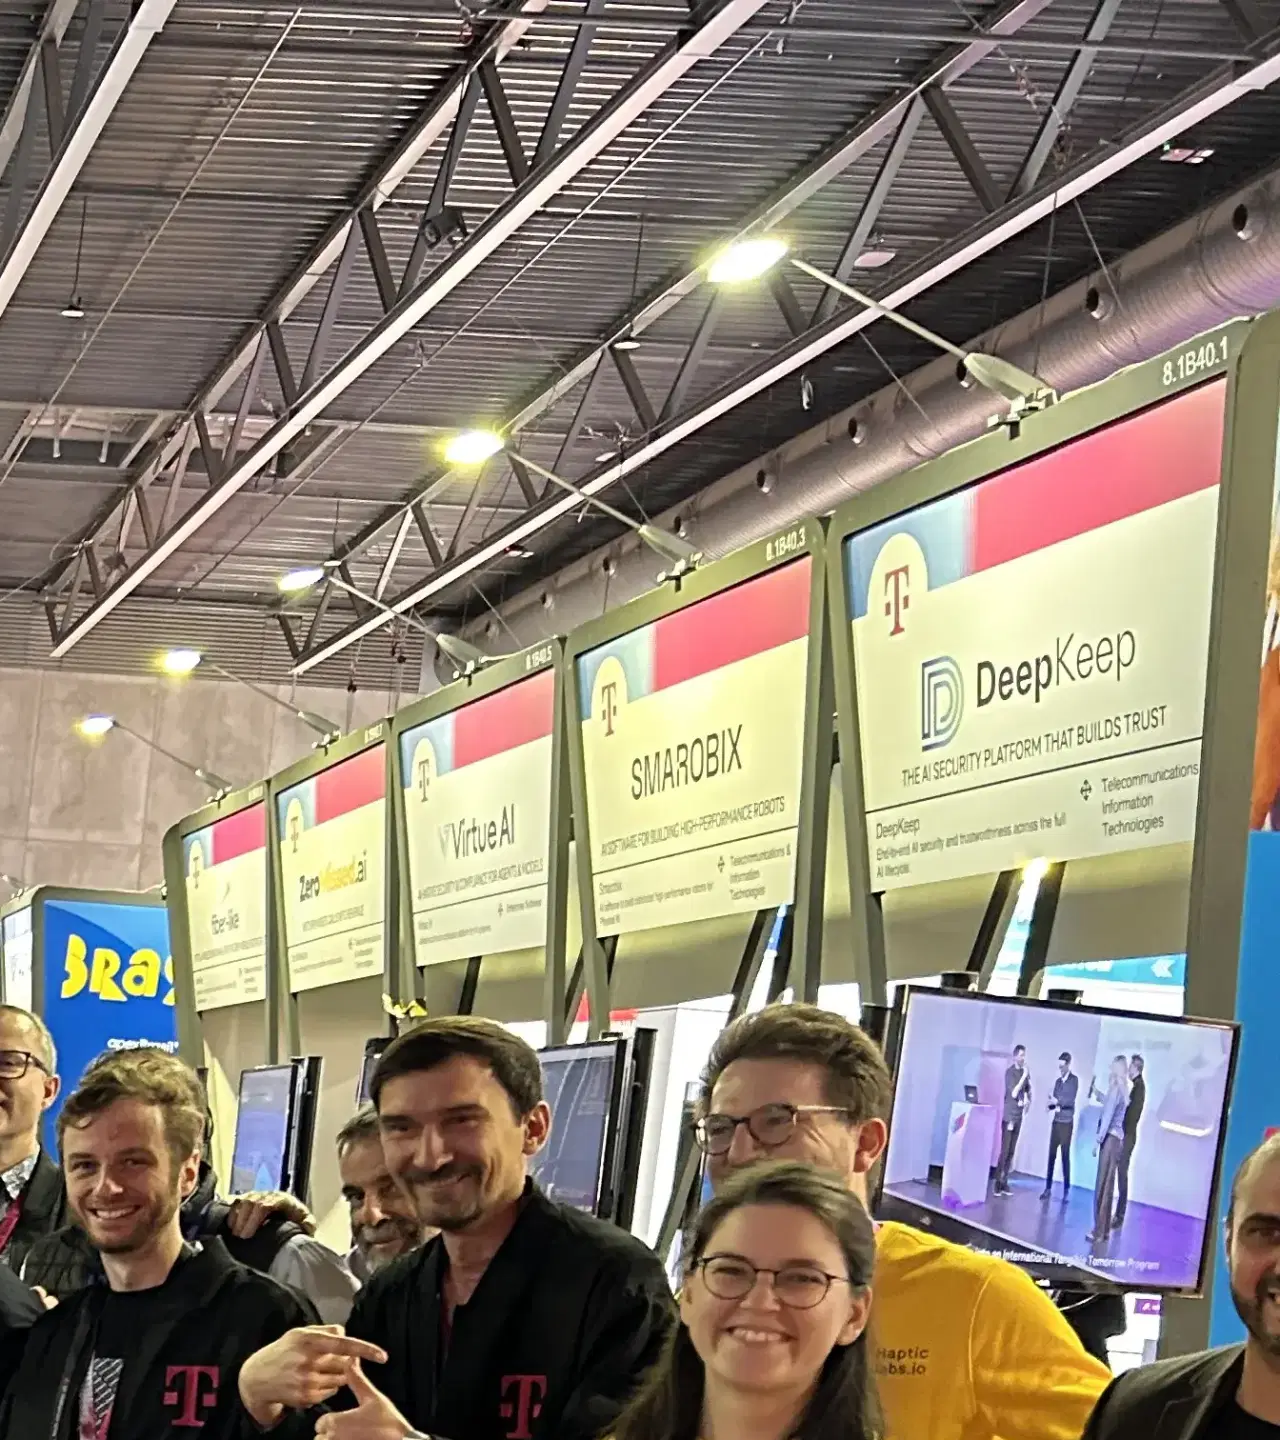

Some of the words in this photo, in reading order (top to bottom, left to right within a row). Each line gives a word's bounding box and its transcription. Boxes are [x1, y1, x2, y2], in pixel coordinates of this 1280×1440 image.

[1162, 335, 1229, 386] 8.1B40.1
[884, 564, 910, 637] T
[977, 629, 1136, 708] DeepKeep
[601, 681, 617, 737] T
[631, 724, 743, 801] SMAROBIX
[902, 764, 922, 788] THE
[922, 762, 932, 783] AI
[932, 751, 982, 781] SECURITY
[984, 737, 1042, 769] PLATFORM
[1044, 727, 1075, 754] THAT
[1077, 715, 1122, 747] BUILDS
[1123, 704, 1168, 735] TRUST
[1101, 762, 1199, 793] Telecommunications
[1101, 793, 1154, 814] Information
[753, 795, 786, 820] ROBOTS
[876, 816, 920, 840] DeepKeep
[1101, 813, 1164, 837] Technologies
[162, 1365, 220, 1427] T
[500, 1375, 547, 1440] T
